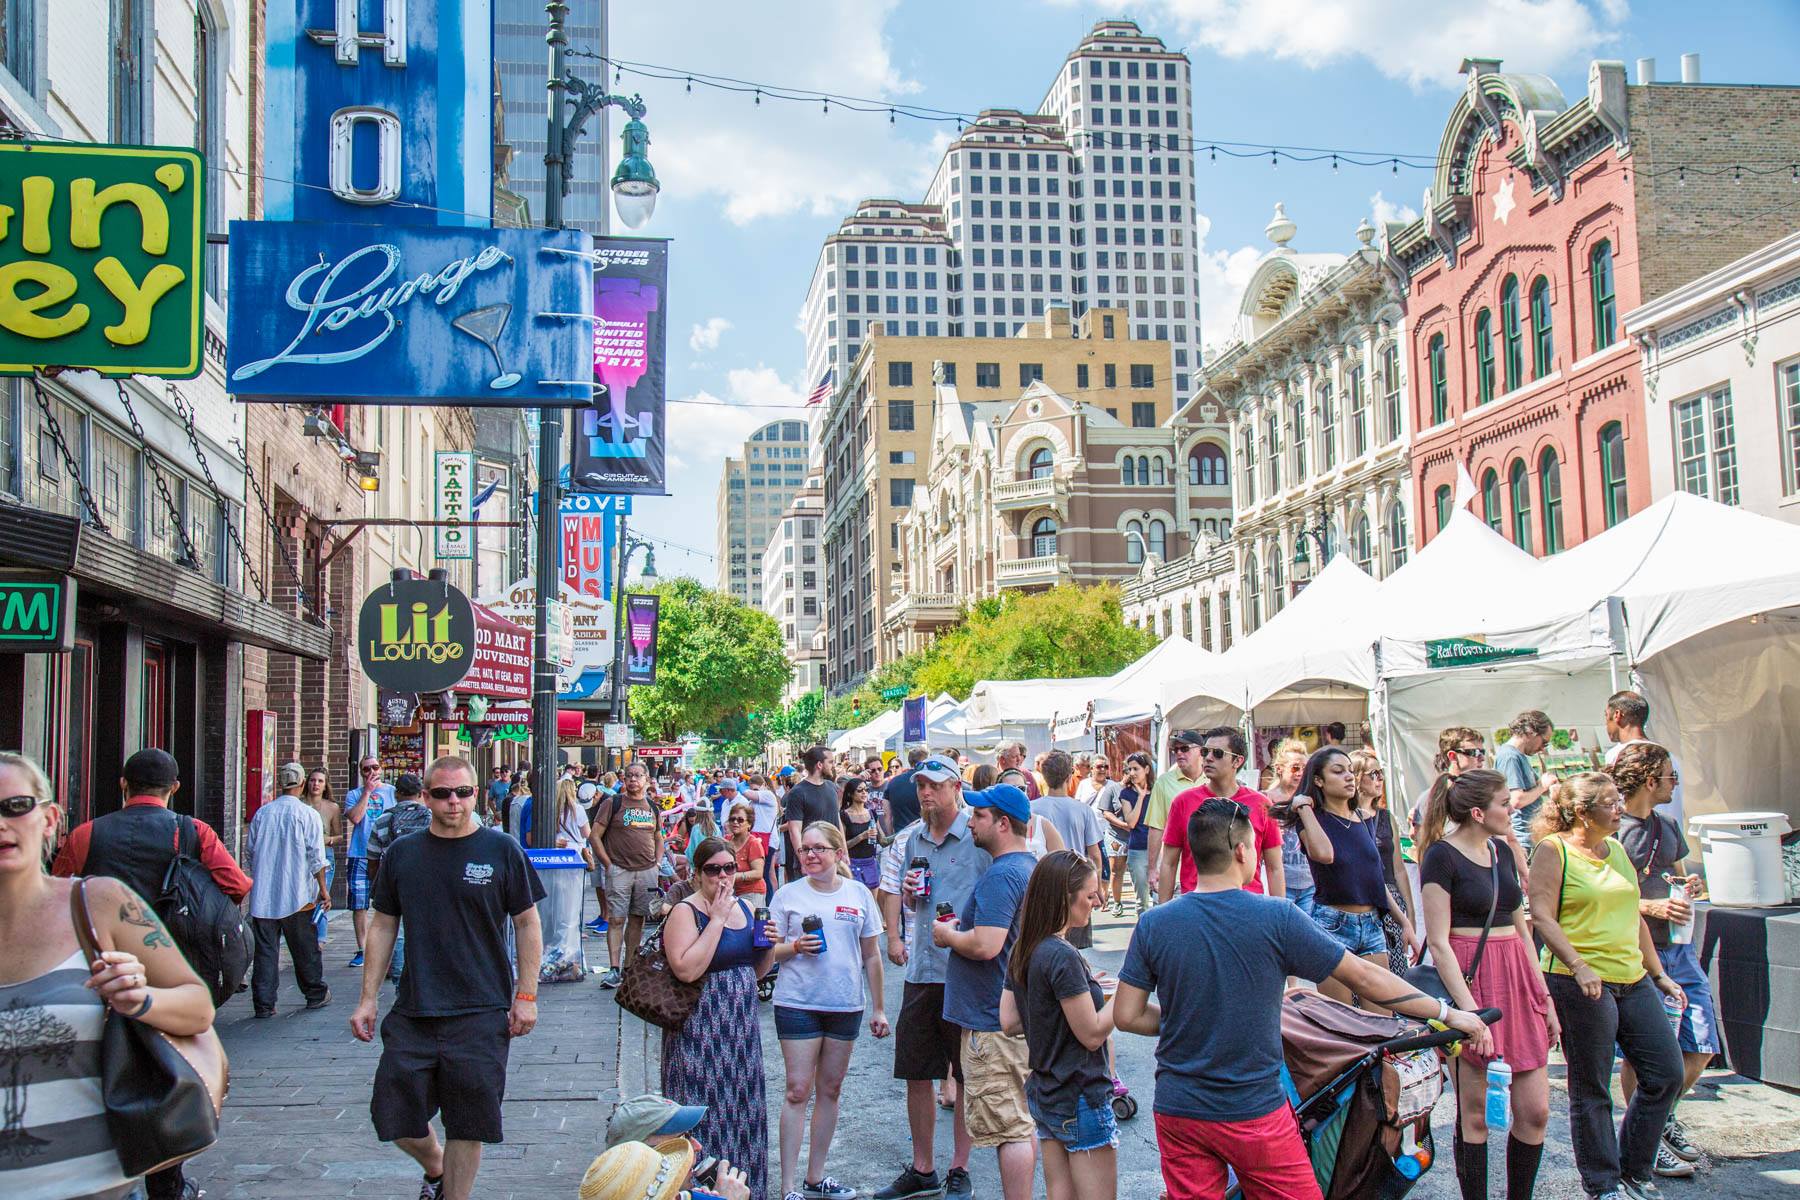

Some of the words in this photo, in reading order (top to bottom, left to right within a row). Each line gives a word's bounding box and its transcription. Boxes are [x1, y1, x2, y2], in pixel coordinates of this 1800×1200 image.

[593, 249, 649, 258] OCTOBER
[232, 243, 508, 381] Lounge
[595, 329, 644, 338] UNITED
[594, 338, 645, 347] STATES
[594, 347, 645, 357] GRAND
[594, 355, 644, 367] PRIX
[444, 464, 462, 542] TATTOO
[564, 518, 579, 578] WILD
[0, 592, 50, 631] M
[380, 602, 454, 645] Lit
[572, 615, 599, 626] ANY
[494, 631, 527, 651] MART
[370, 640, 464, 664] Lounge
[1436, 644, 1453, 659] Real
[1453, 643, 1483, 657] Flowers
[1740, 822, 1769, 831] BRUTE
